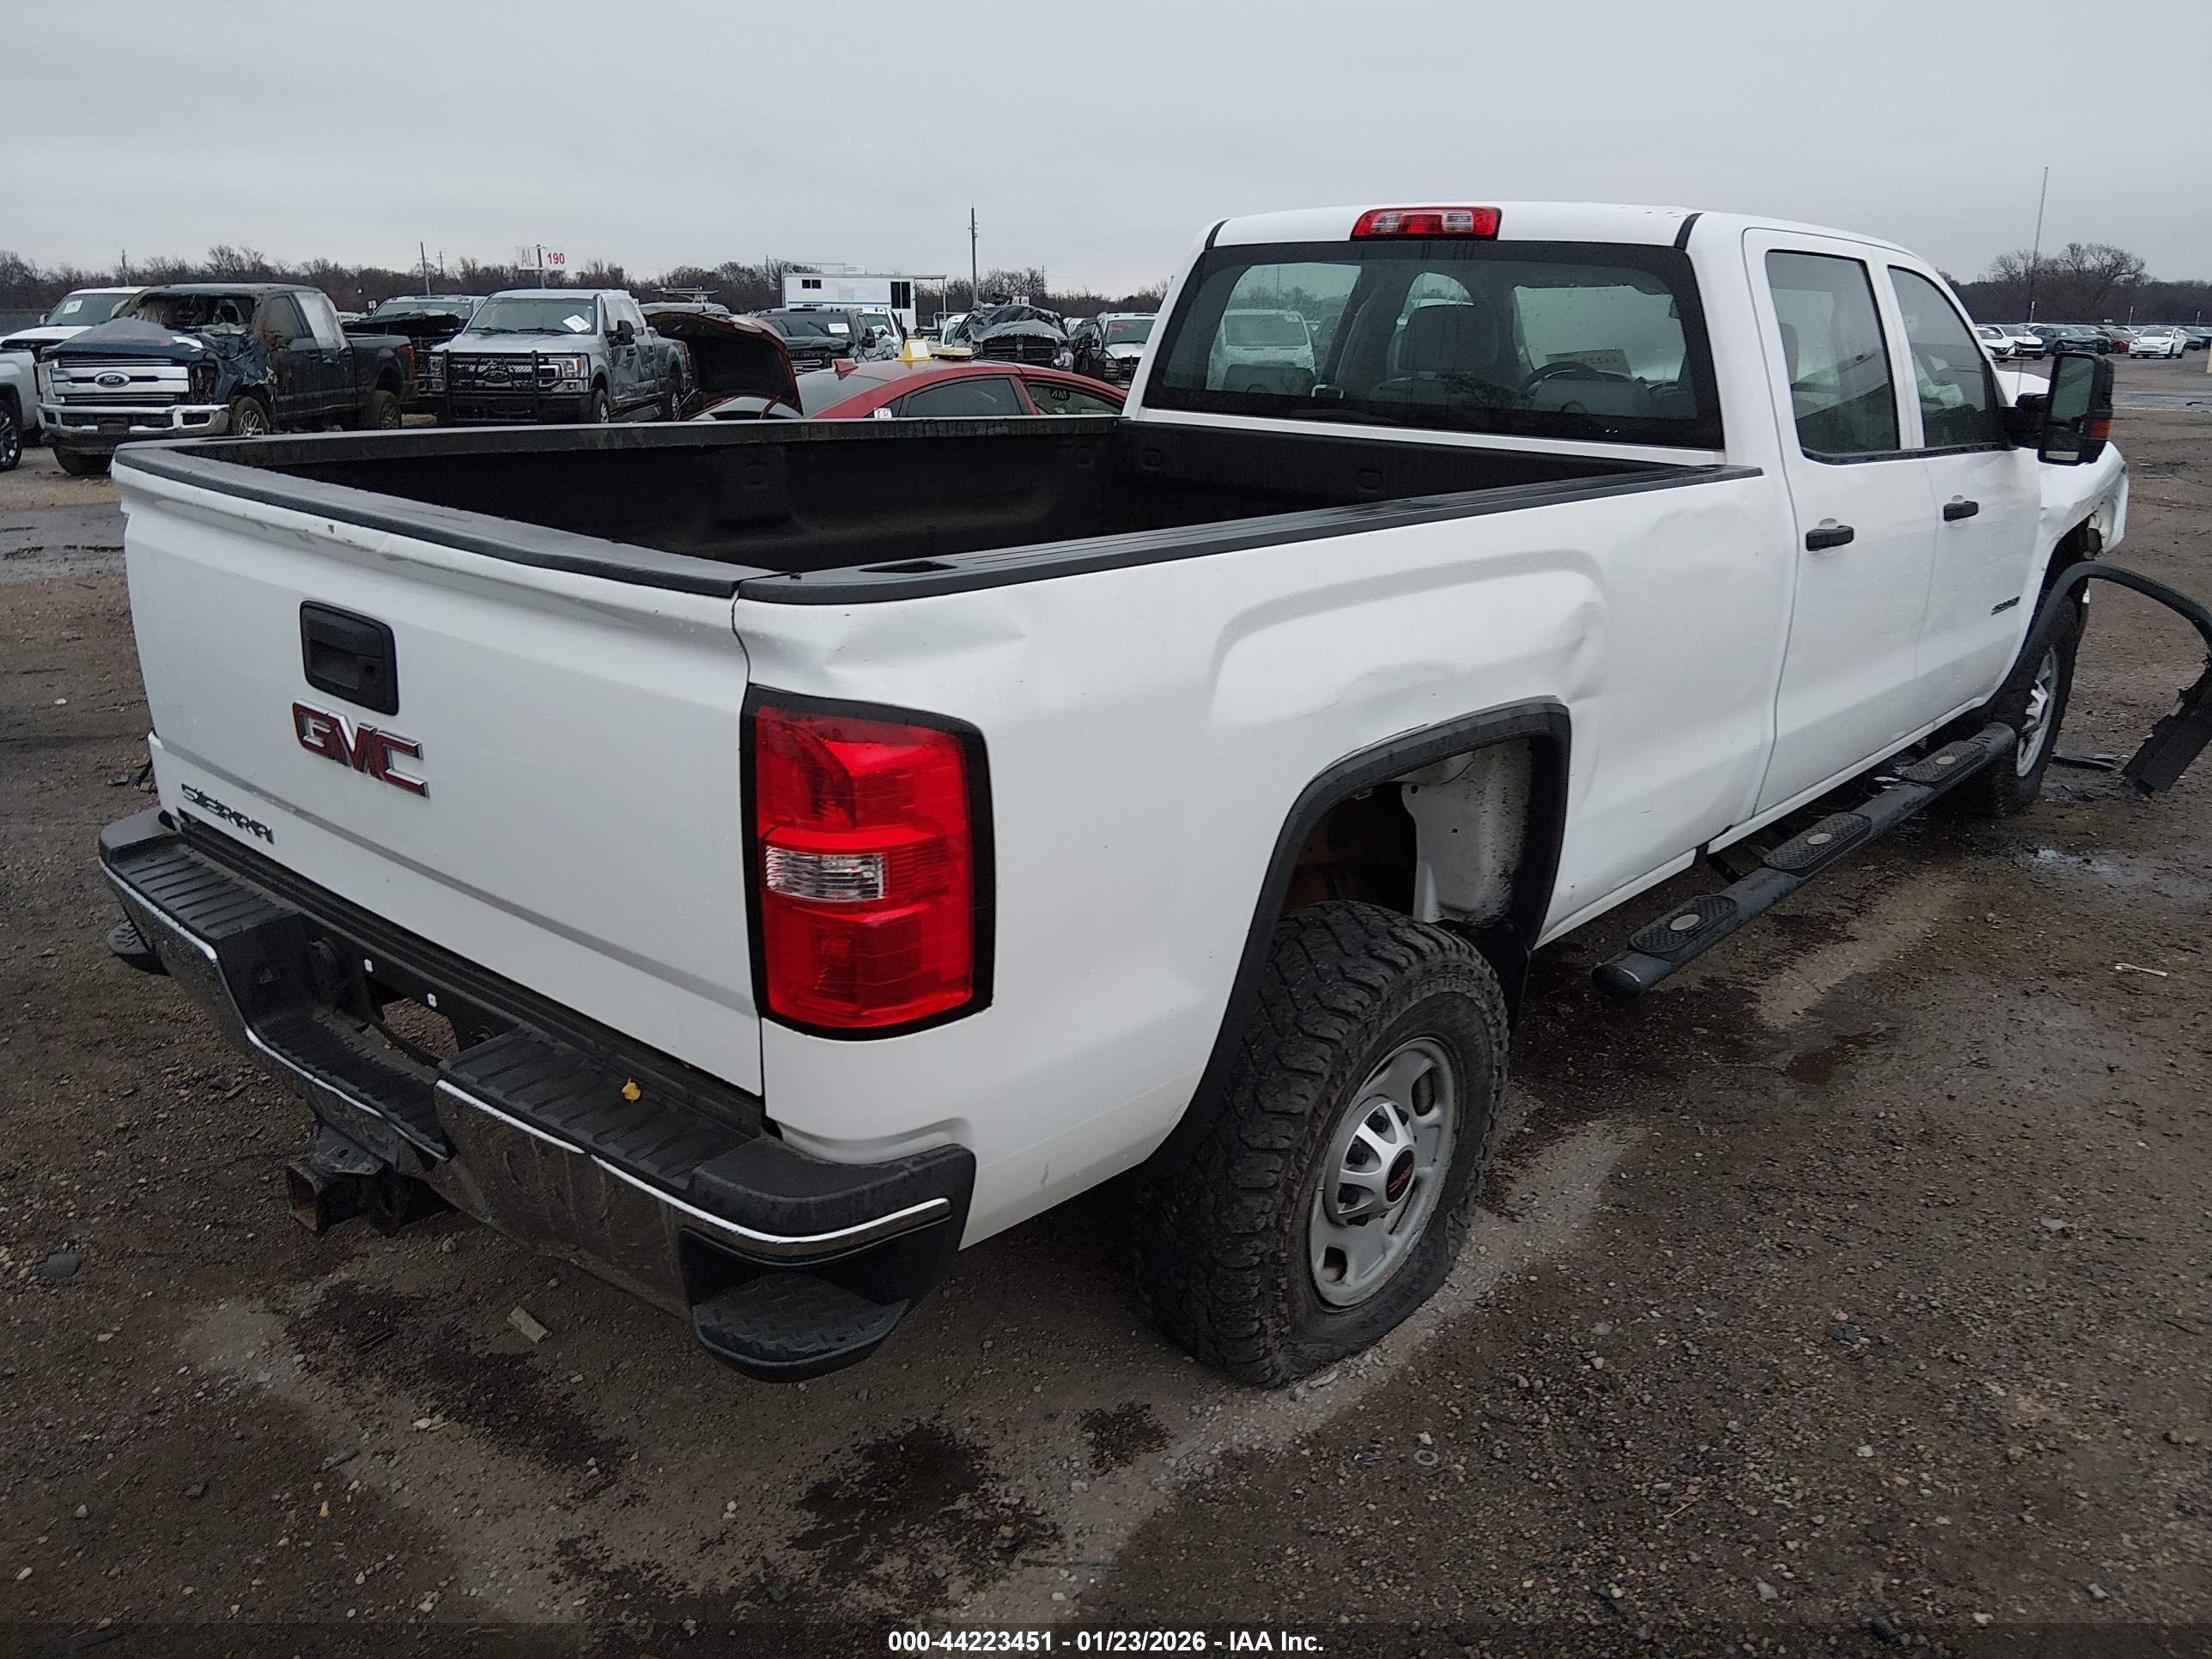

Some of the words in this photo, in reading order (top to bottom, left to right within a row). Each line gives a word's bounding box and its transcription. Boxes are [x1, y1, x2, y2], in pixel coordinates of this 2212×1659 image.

[547, 252, 565, 264] 190
[292, 700, 430, 799] GMC
[181, 783, 275, 845] SIERRA
